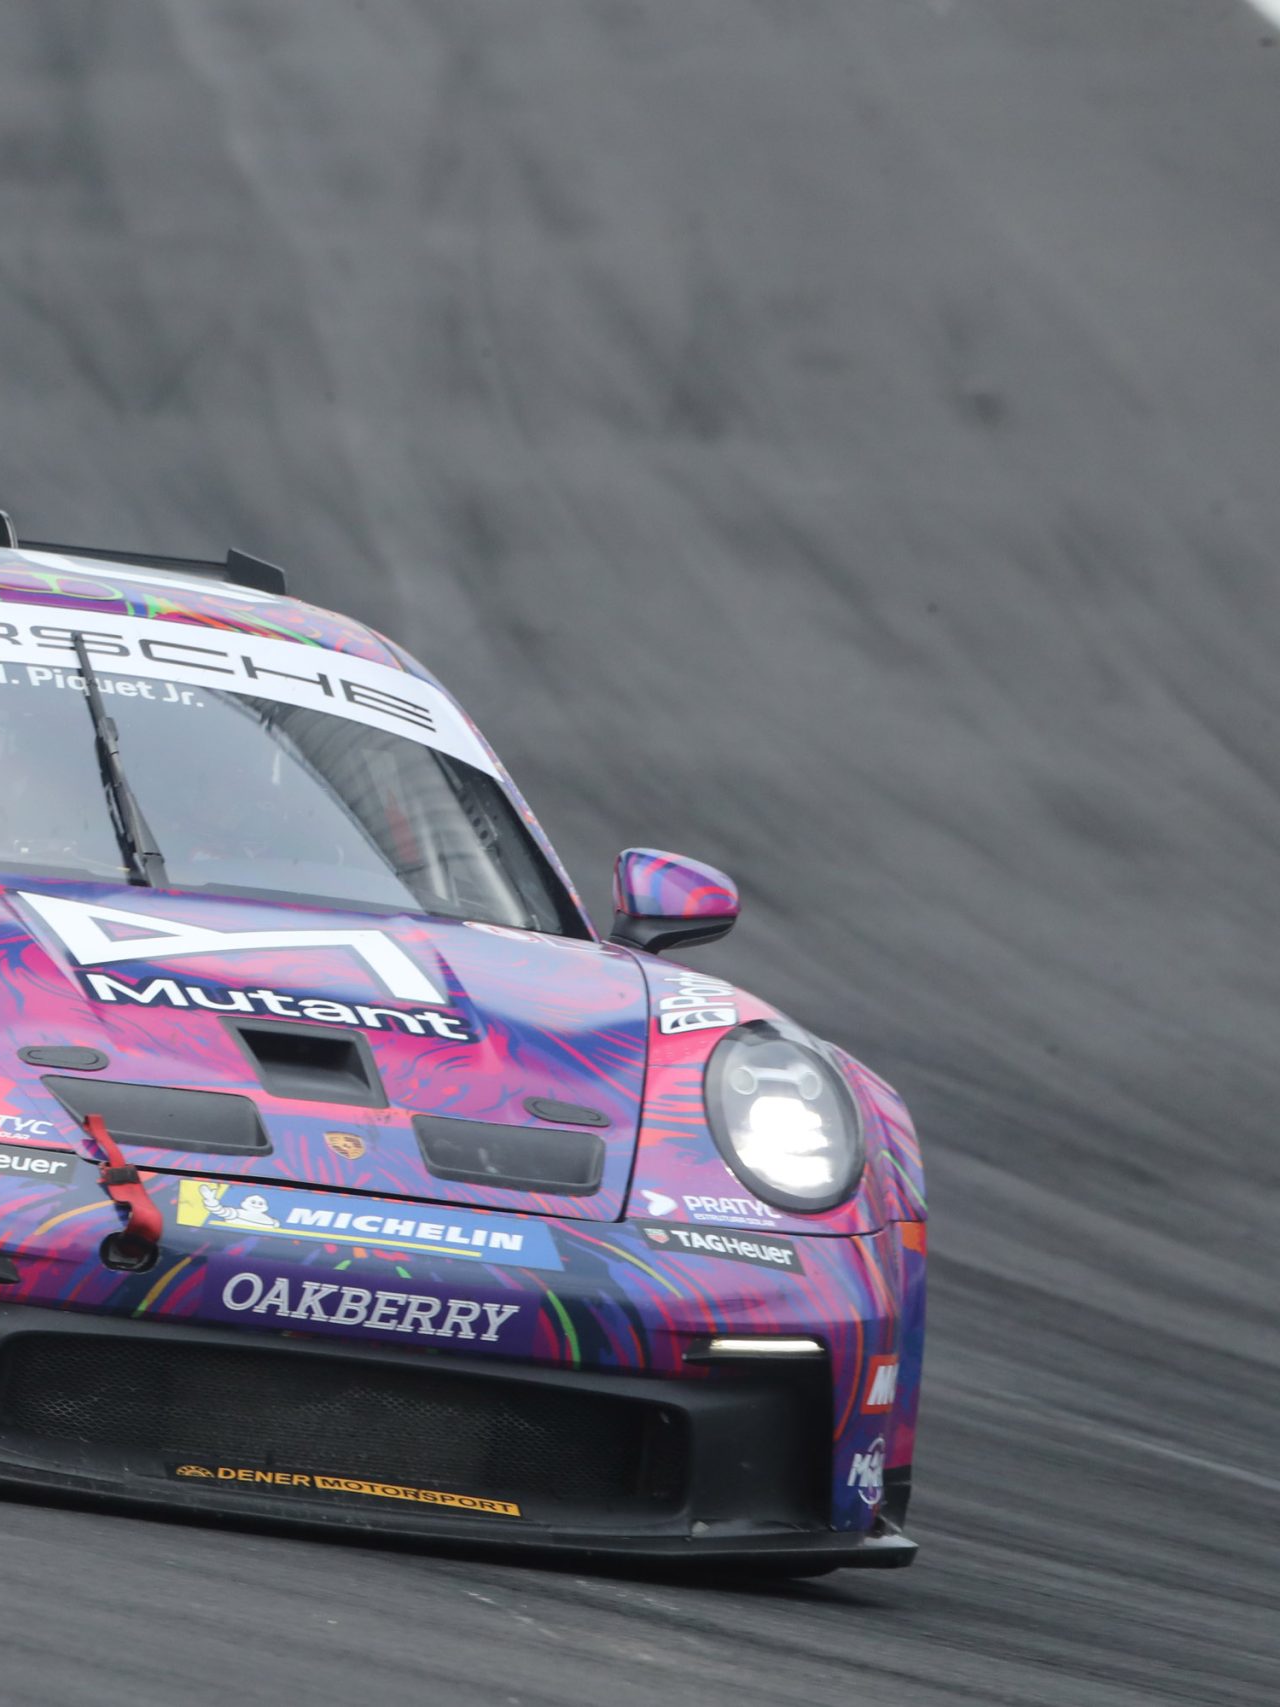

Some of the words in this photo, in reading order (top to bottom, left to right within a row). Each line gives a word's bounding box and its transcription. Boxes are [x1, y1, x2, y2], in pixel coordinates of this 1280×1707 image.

[29, 667, 154, 700] Piquet
[163, 684, 205, 708] Jr.
[85, 973, 469, 1040] Mutant
[286, 1207, 524, 1251] MICHELIN
[222, 1272, 521, 1343] OAKBERRY
[218, 1467, 313, 1488] DENER
[320, 1477, 514, 1513] MOTORSPORT
